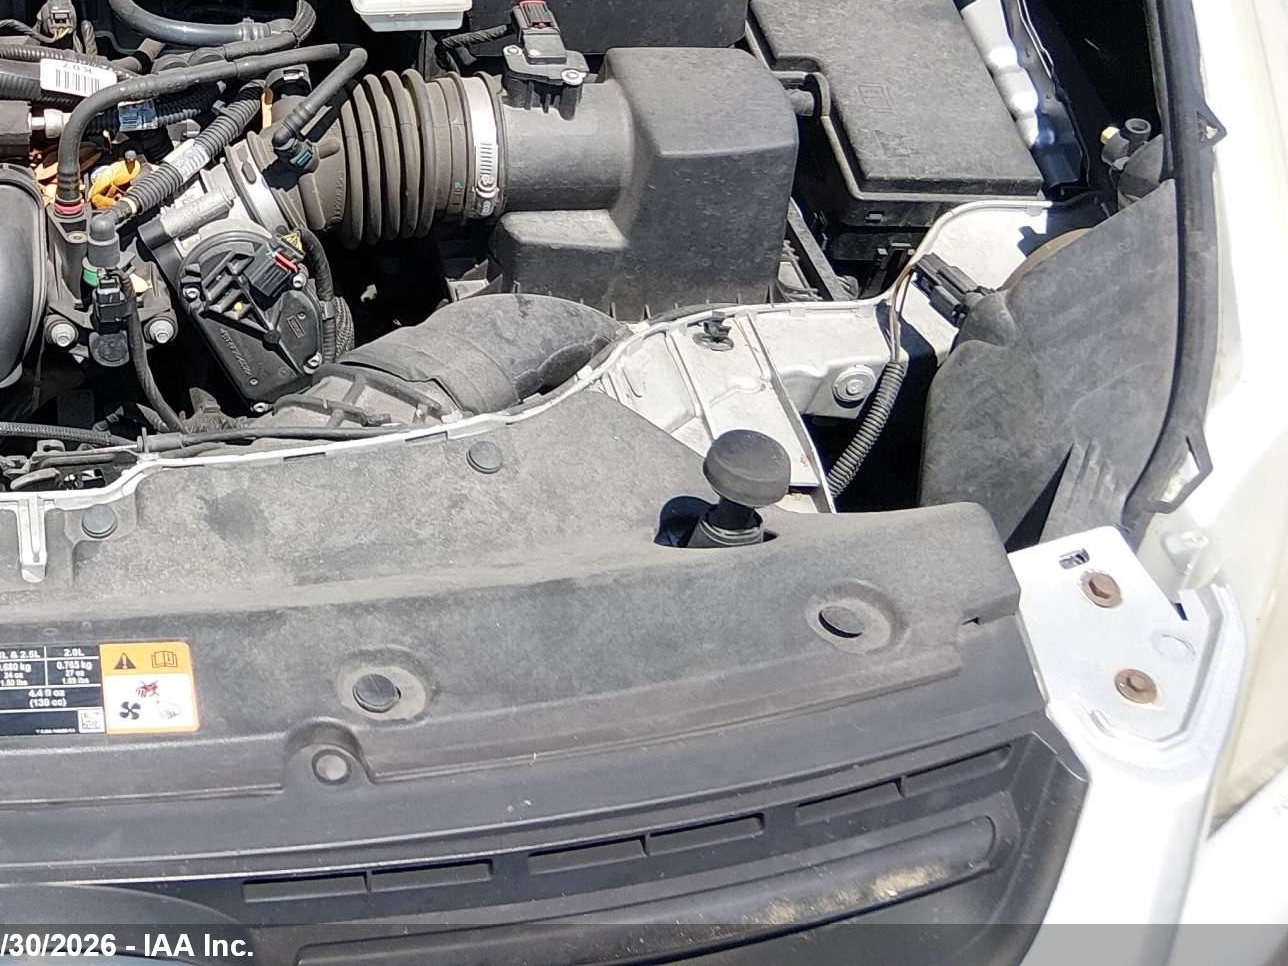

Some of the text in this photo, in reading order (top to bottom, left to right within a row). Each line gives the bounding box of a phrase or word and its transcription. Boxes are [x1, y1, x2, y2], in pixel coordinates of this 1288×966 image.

[19, 649, 41, 659] 2.5L
[63, 647, 85, 657] 2.0L
[19, 662, 32, 673] kg
[81, 659, 93, 671] kg
[53, 689, 66, 697] oz
